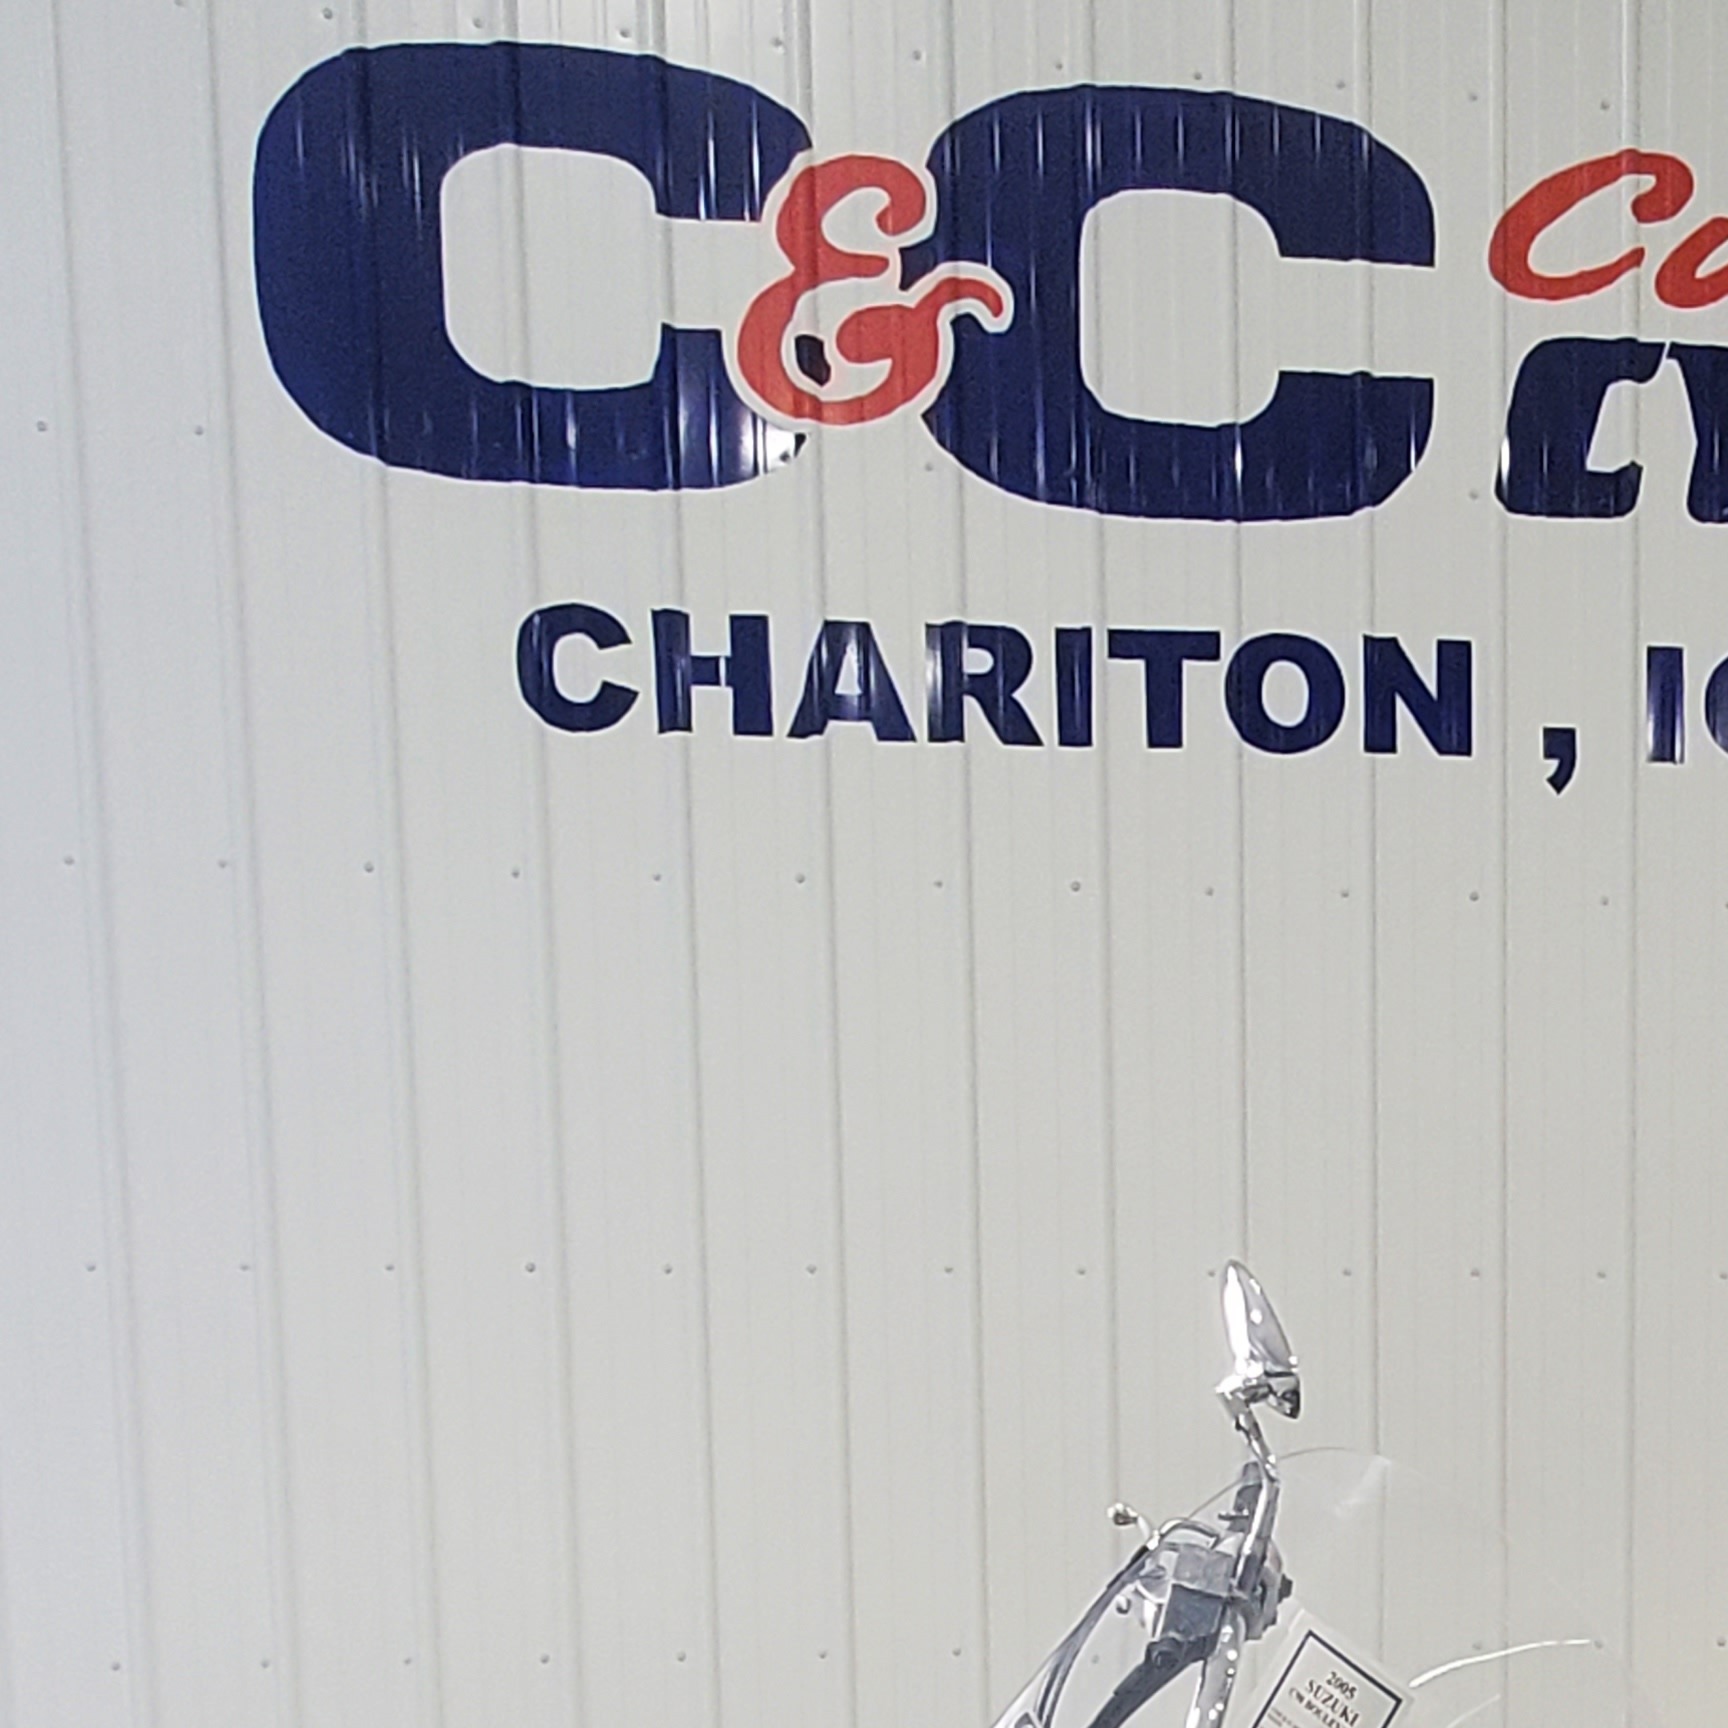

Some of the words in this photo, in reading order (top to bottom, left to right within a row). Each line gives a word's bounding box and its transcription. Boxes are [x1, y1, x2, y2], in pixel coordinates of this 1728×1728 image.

[253, 40, 1436, 522] C&C
[516, 602, 1474, 757] CHARITON
[1306, 1680, 1359, 1727] SUZUKI
[1325, 1671, 1357, 1700] 2005
